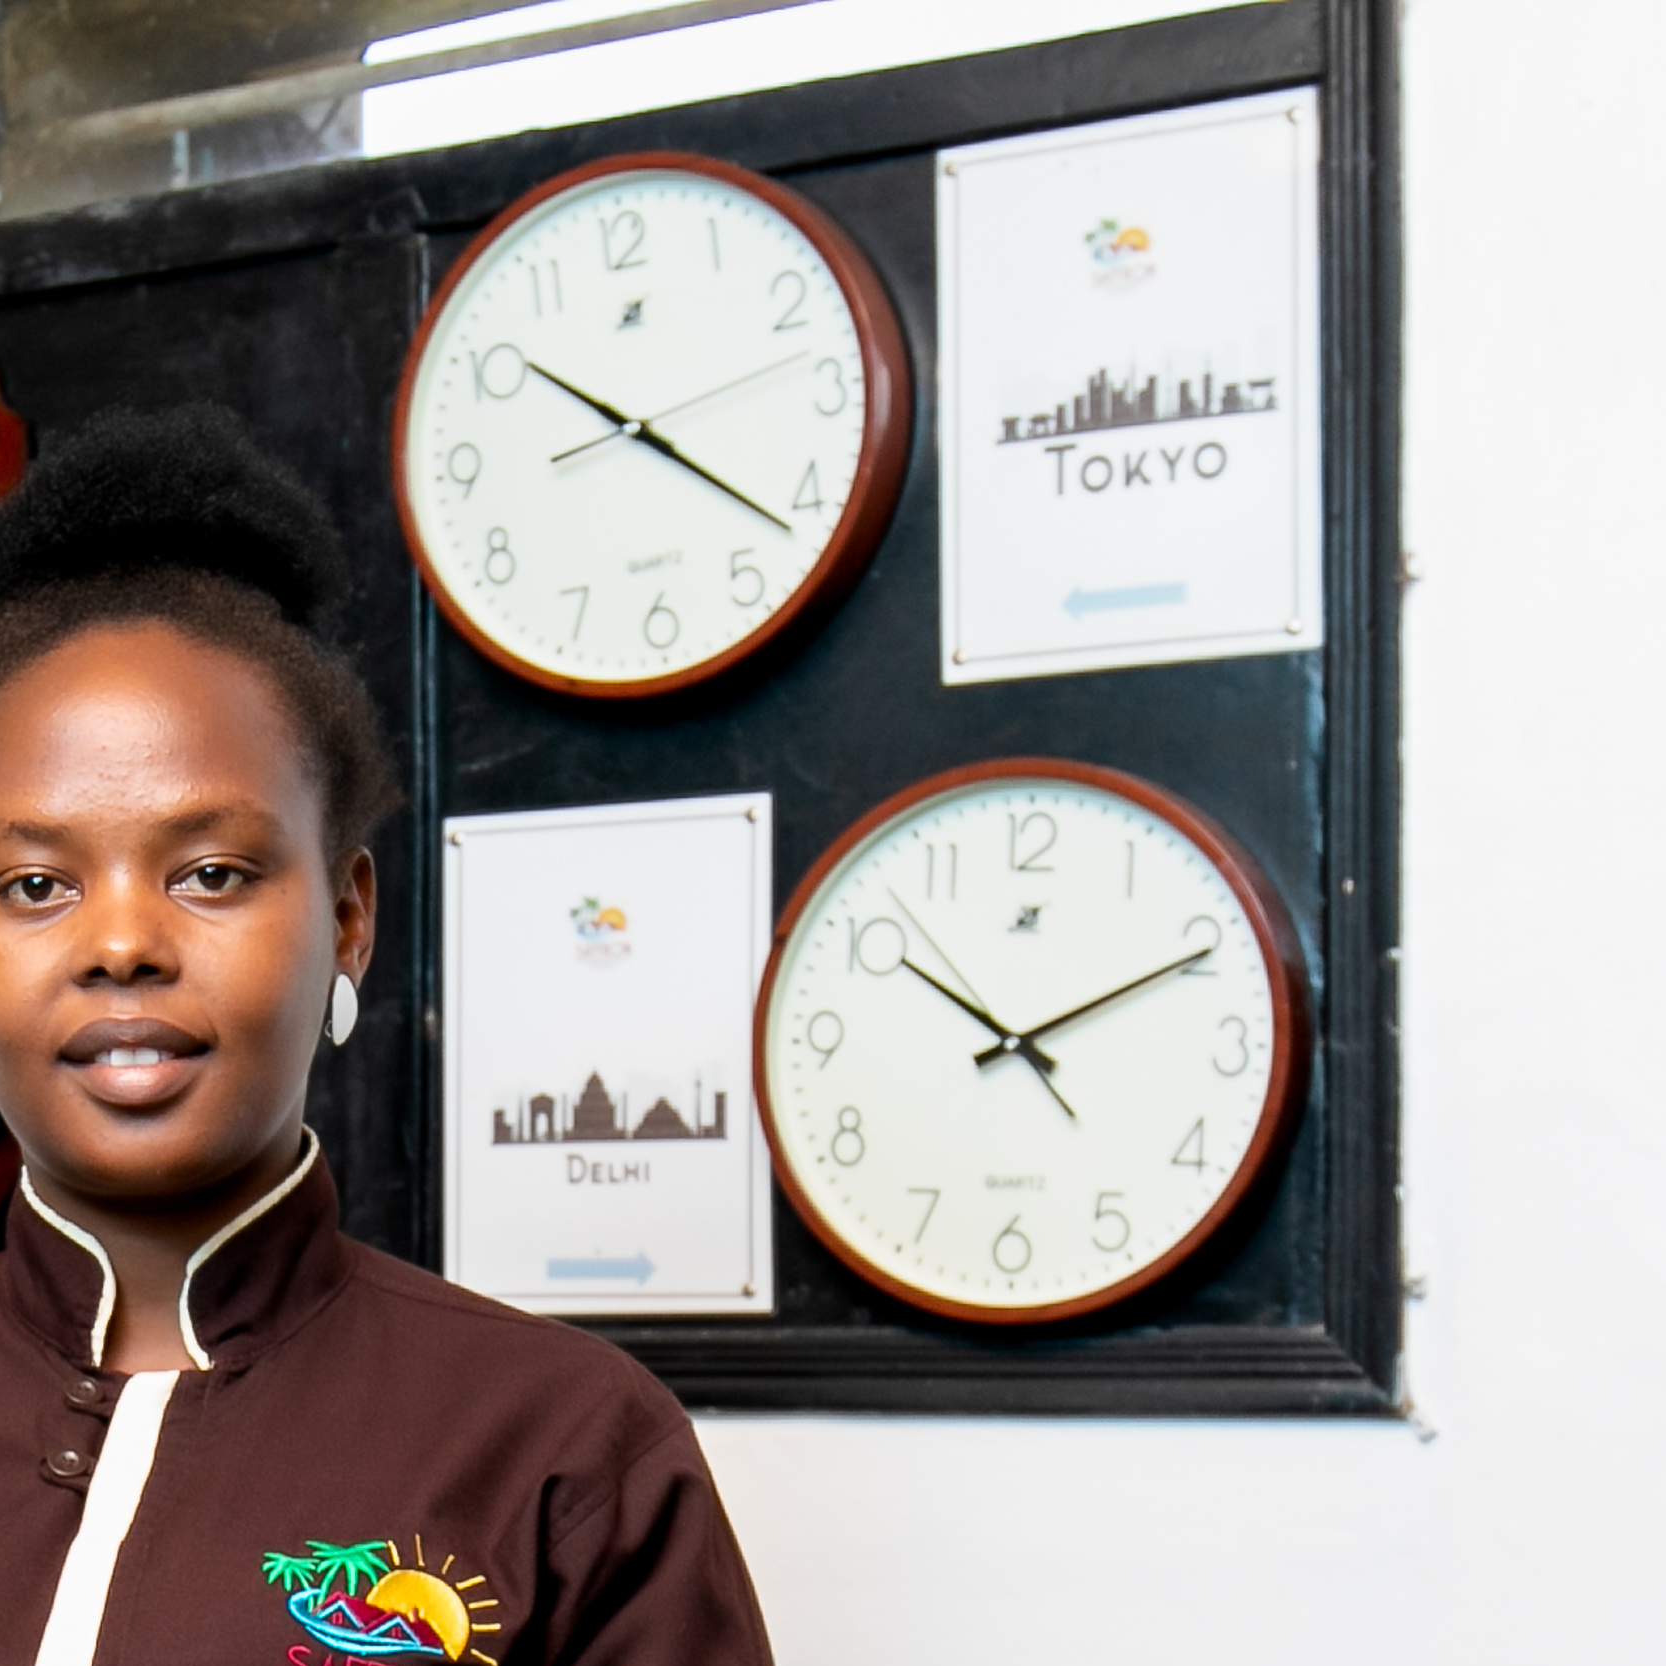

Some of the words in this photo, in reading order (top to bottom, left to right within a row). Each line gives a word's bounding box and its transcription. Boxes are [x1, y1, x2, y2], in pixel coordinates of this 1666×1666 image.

[599, 210, 648, 271] 12
[708, 217, 720, 271] 1
[530, 259, 563, 318] 11
[770, 269, 809, 332] 2
[471, 343, 527, 402] 10
[813, 358, 847, 415] 3
[447, 442, 482, 500] 9
[791, 459, 825, 514] 4
[1044, 441, 1228, 496] TOKYO
[484, 526, 516, 585] 8
[730, 548, 766, 608] 5
[560, 585, 590, 641] 7
[643, 591, 680, 649] 6
[1007, 811, 1058, 872] 12
[1126, 839, 1135, 899] 1
[926, 843, 957, 901] 11
[847, 917, 908, 976] 10
[1179, 914, 1222, 976] 2
[807, 1010, 845, 1071] 9
[1212, 1015, 1250, 1077] 3
[831, 1104, 866, 1167] 8
[1170, 1116, 1208, 1175] 4
[907, 1187, 941, 1245] 7
[992, 1214, 1032, 1274] 6
[1091, 1191, 1131, 1252] 5
